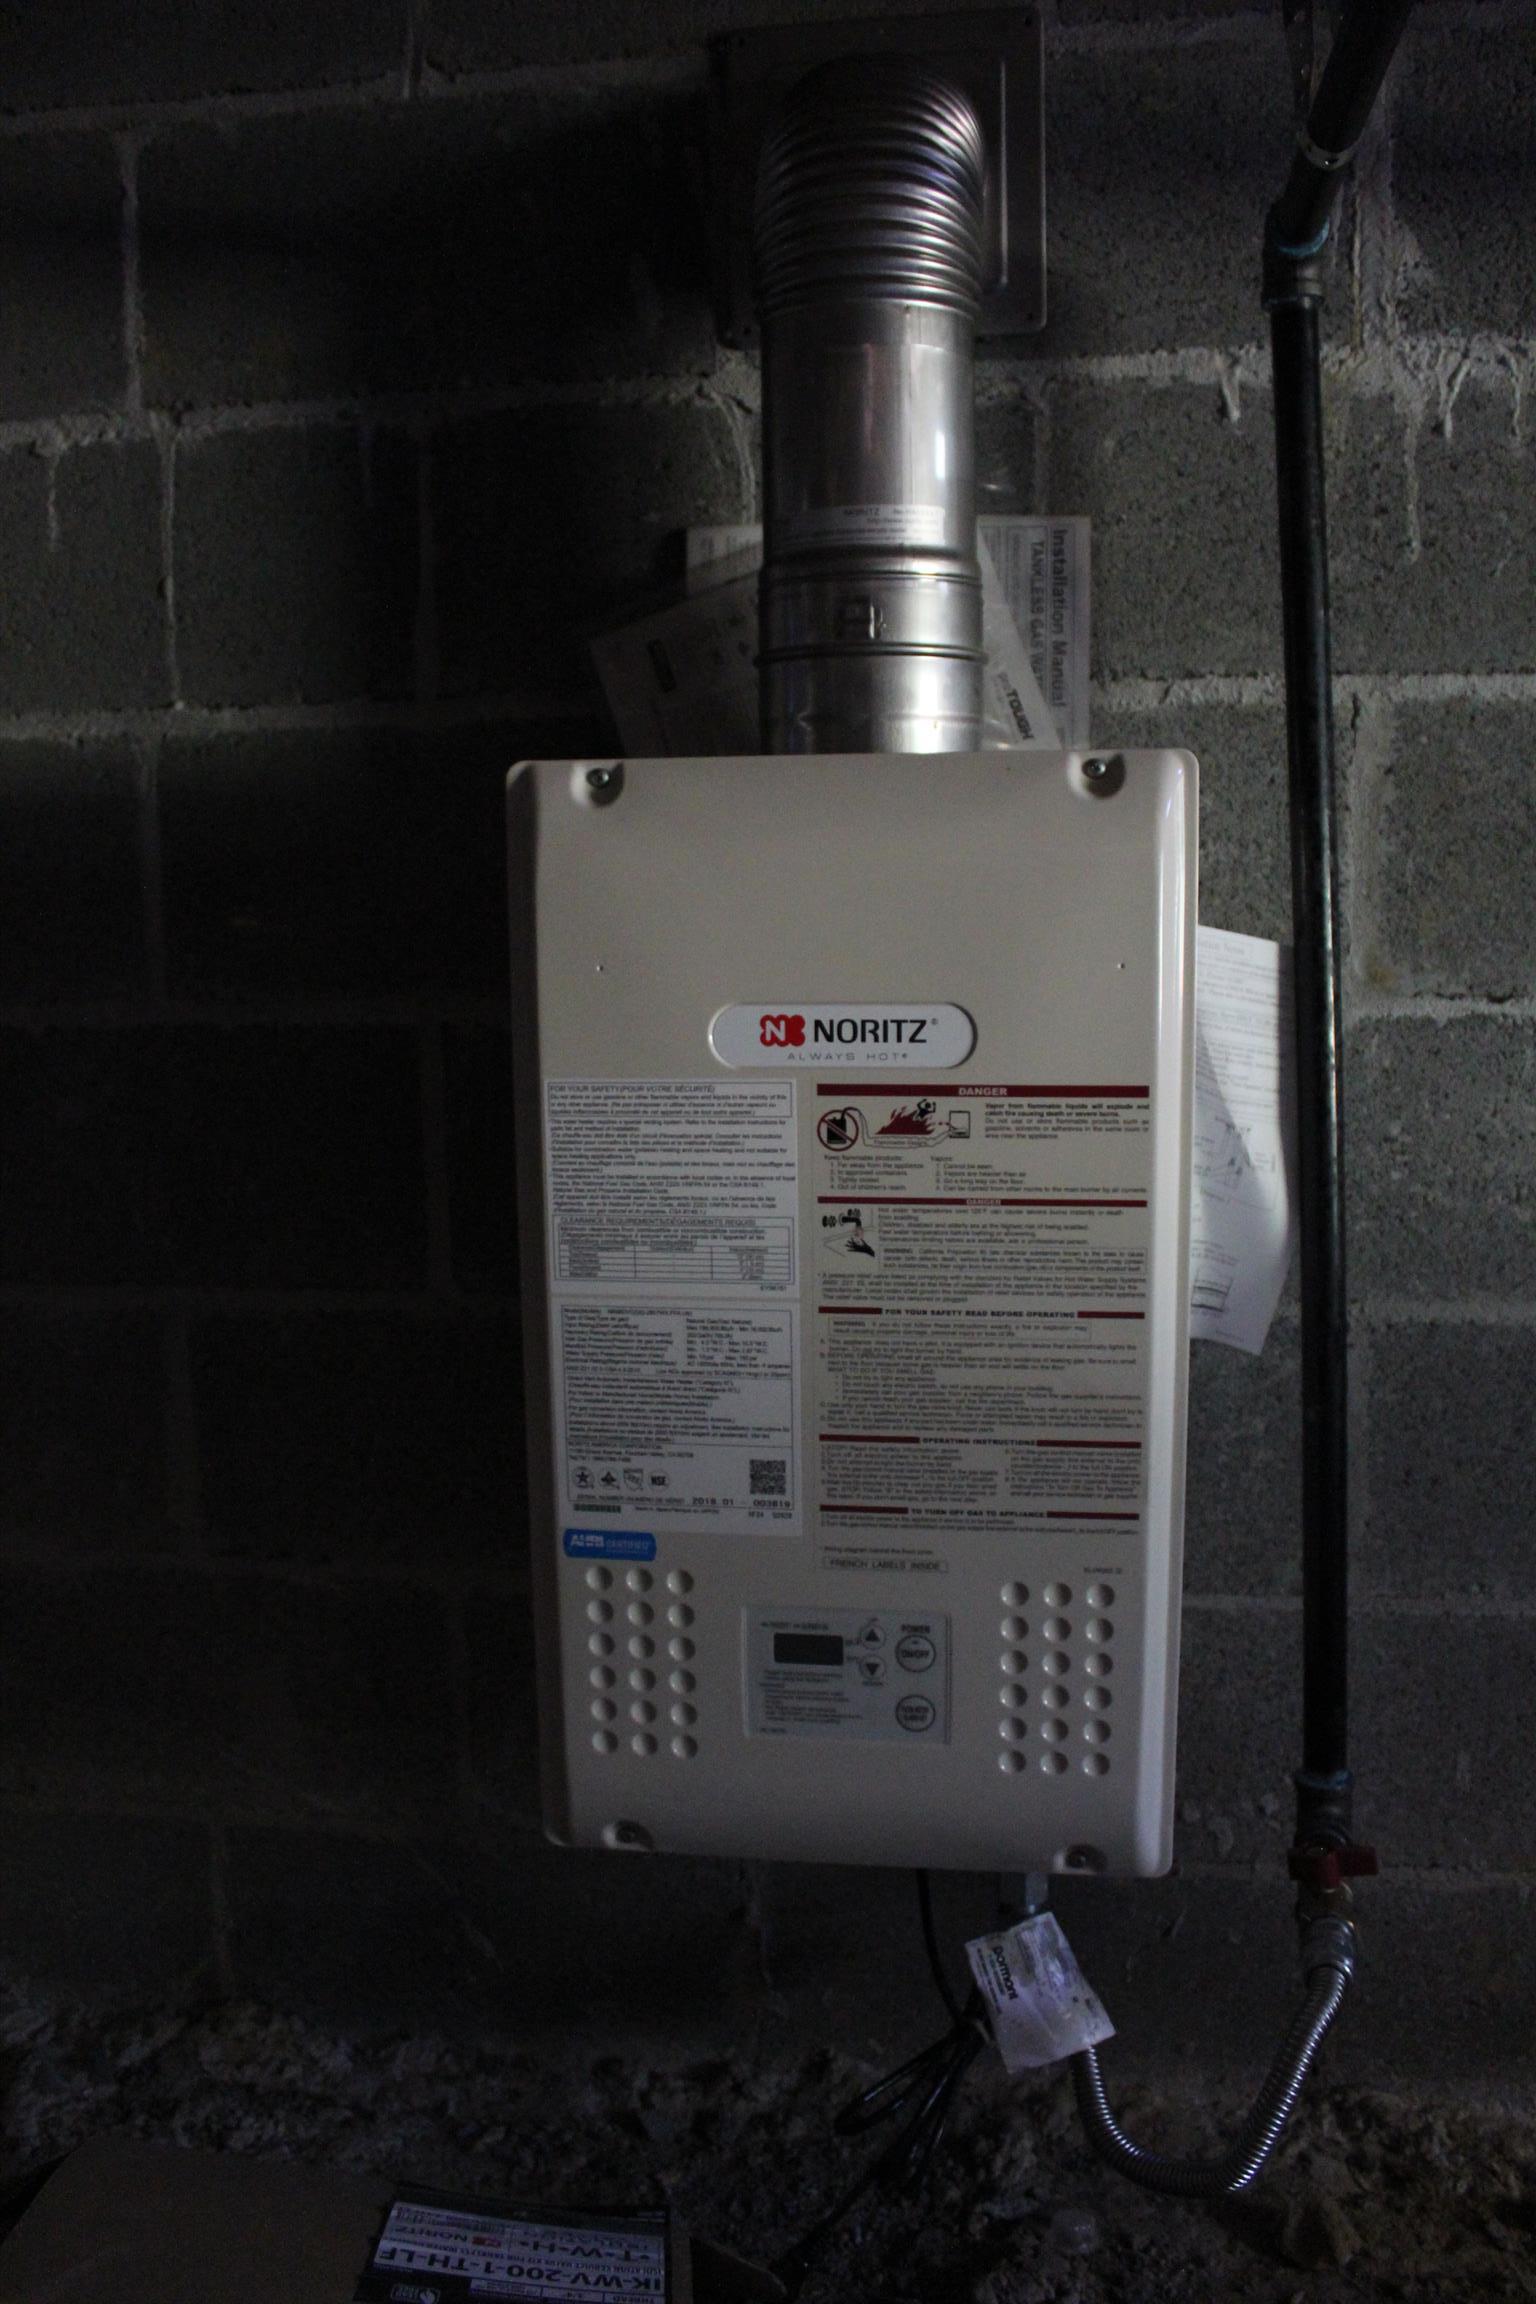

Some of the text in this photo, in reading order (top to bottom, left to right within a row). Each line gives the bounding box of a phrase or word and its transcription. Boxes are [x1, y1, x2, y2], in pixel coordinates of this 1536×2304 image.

[1052, 529, 1069, 708] Installation Manual
[813, 1018, 928, 1044] NORITZ
[786, 1051, 901, 1062] ALWAYS HOT
[958, 1087, 1008, 1096] DANGER
